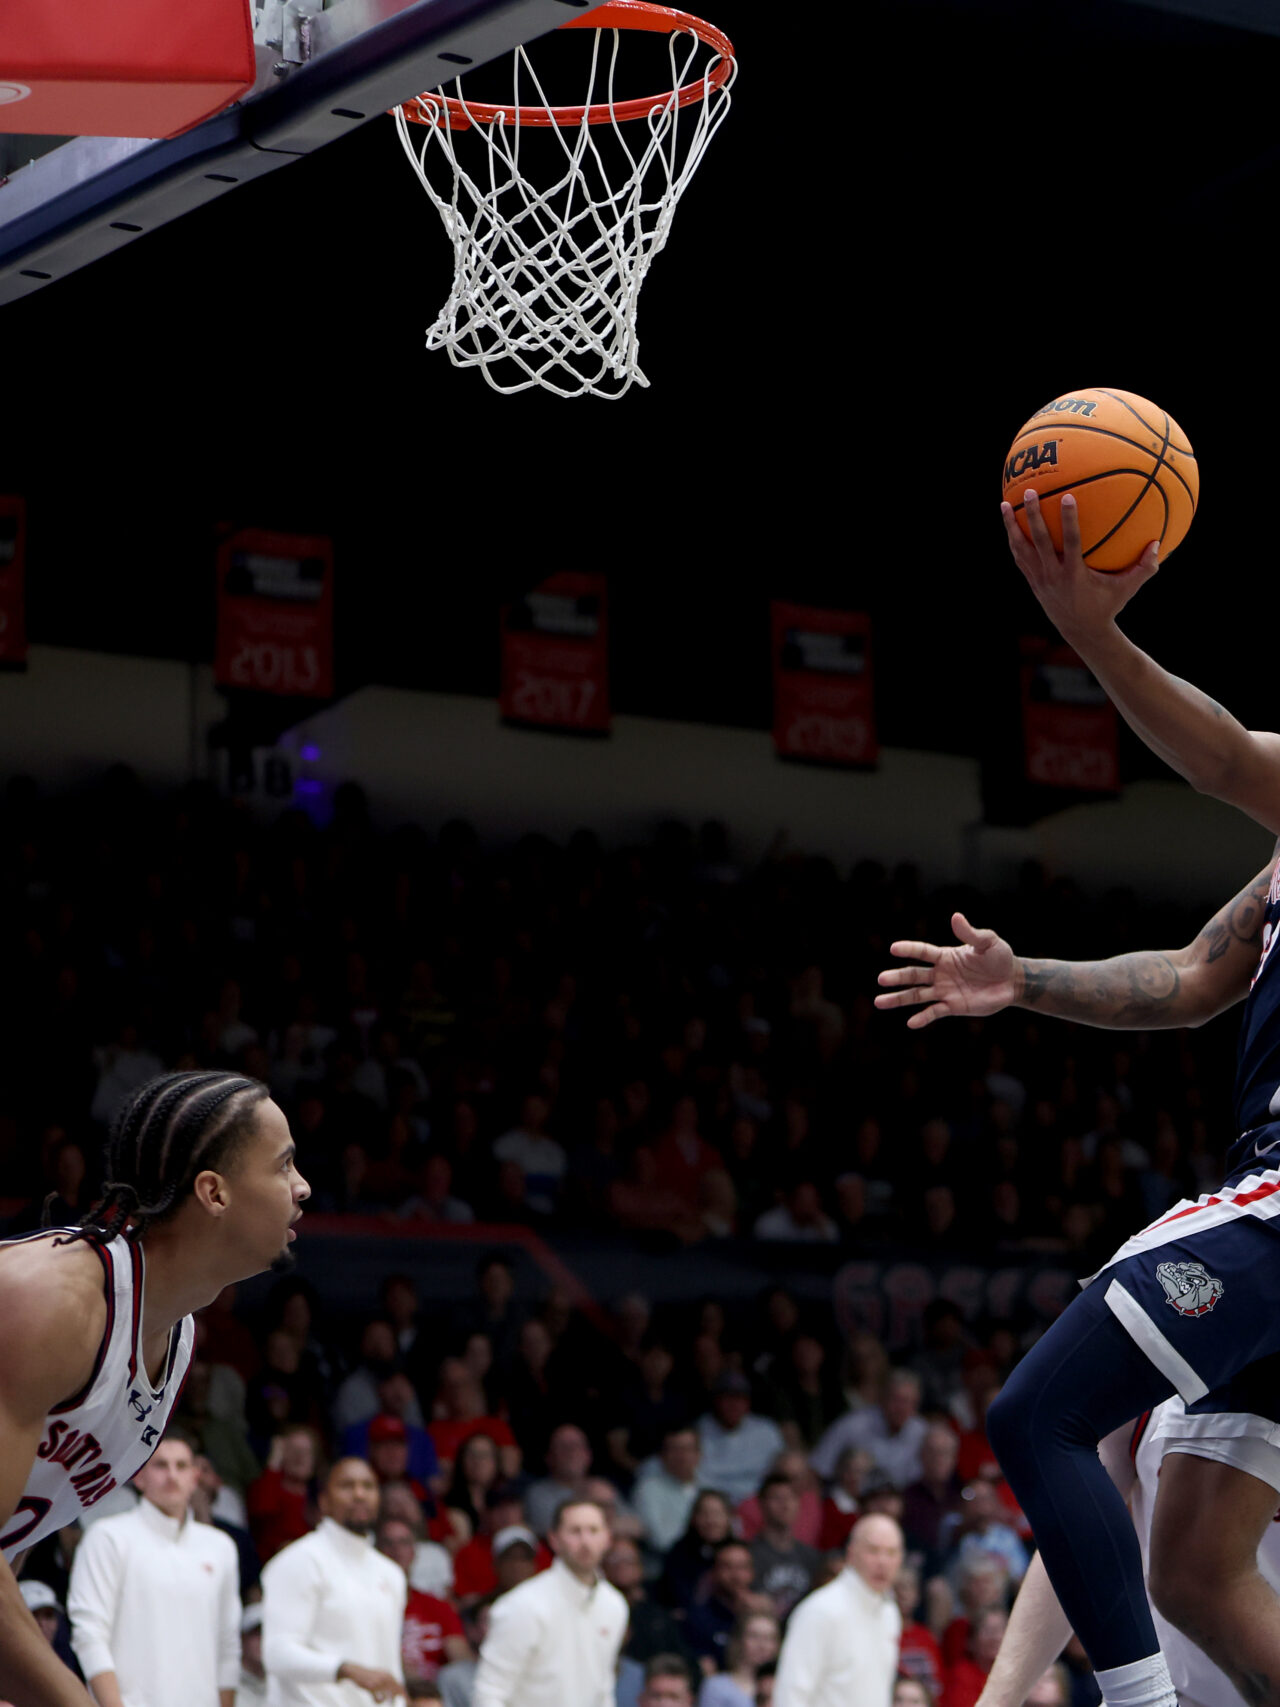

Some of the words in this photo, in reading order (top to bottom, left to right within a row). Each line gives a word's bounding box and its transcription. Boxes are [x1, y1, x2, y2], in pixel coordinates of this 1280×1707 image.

[1032, 399, 1097, 417] son
[1004, 441, 1058, 483] NCAA
[512, 671, 597, 722] 2017
